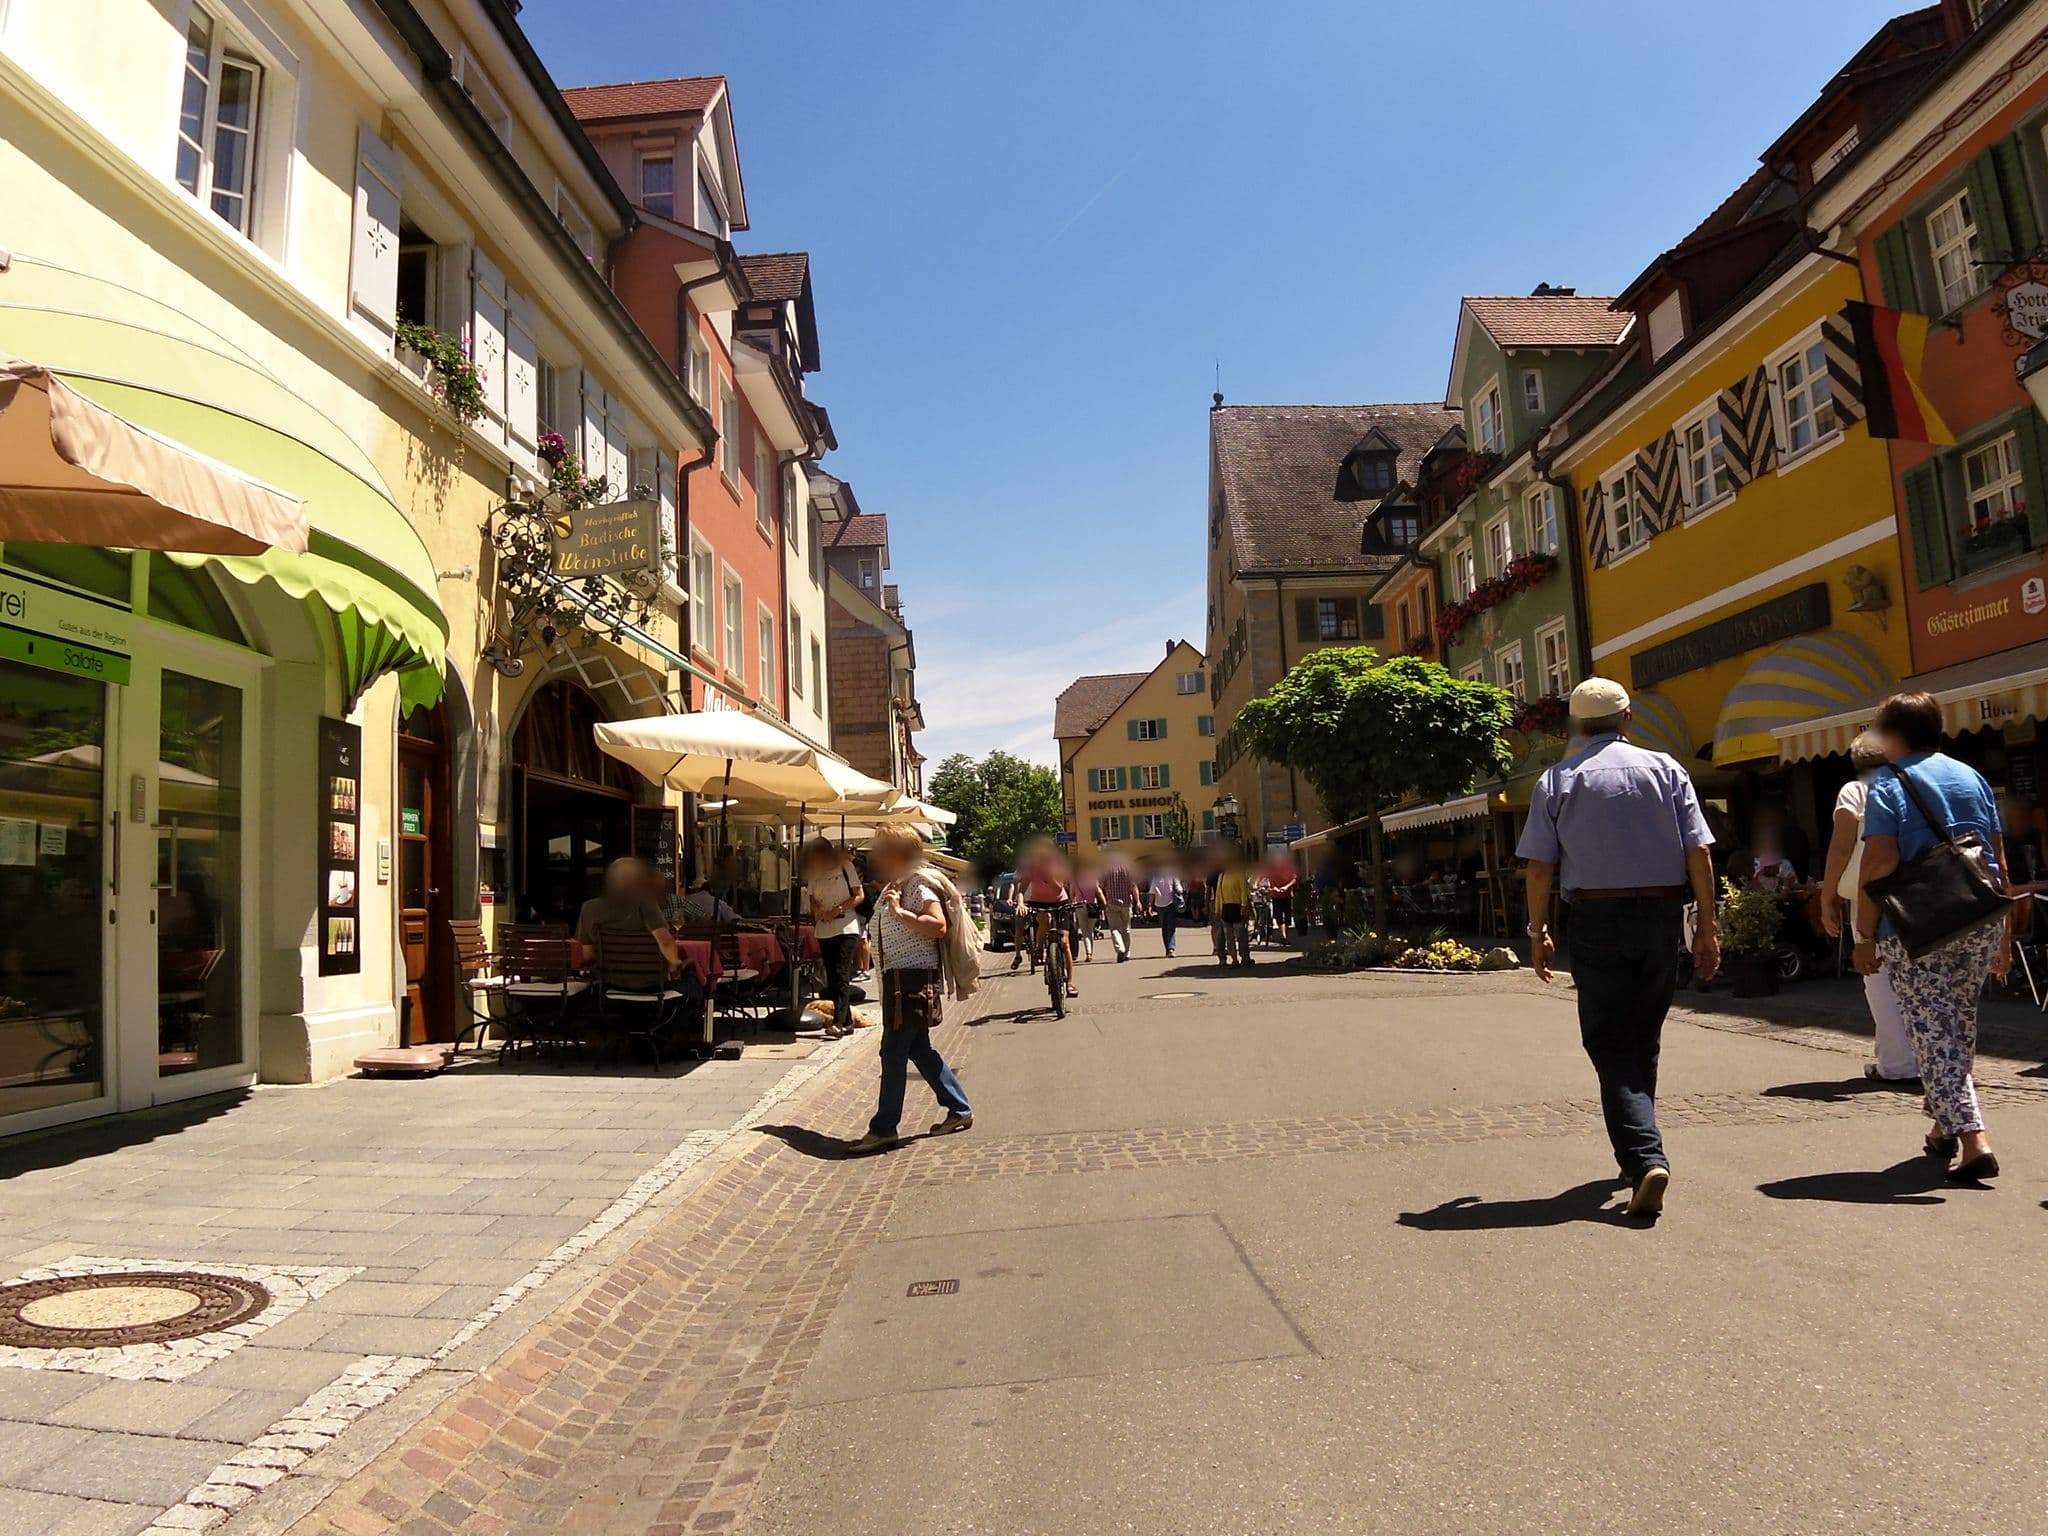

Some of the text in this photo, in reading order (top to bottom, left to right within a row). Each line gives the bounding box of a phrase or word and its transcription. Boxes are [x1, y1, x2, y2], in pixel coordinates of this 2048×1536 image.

[580, 526, 637, 547] Badische
[559, 543, 647, 571] Weinstube
[1927, 597, 2009, 637] Gästezimmer
[58, 619, 127, 646] Gutes aus der Region
[63, 647, 104, 673] Salate
[1088, 798, 1126, 811] HOTEL
